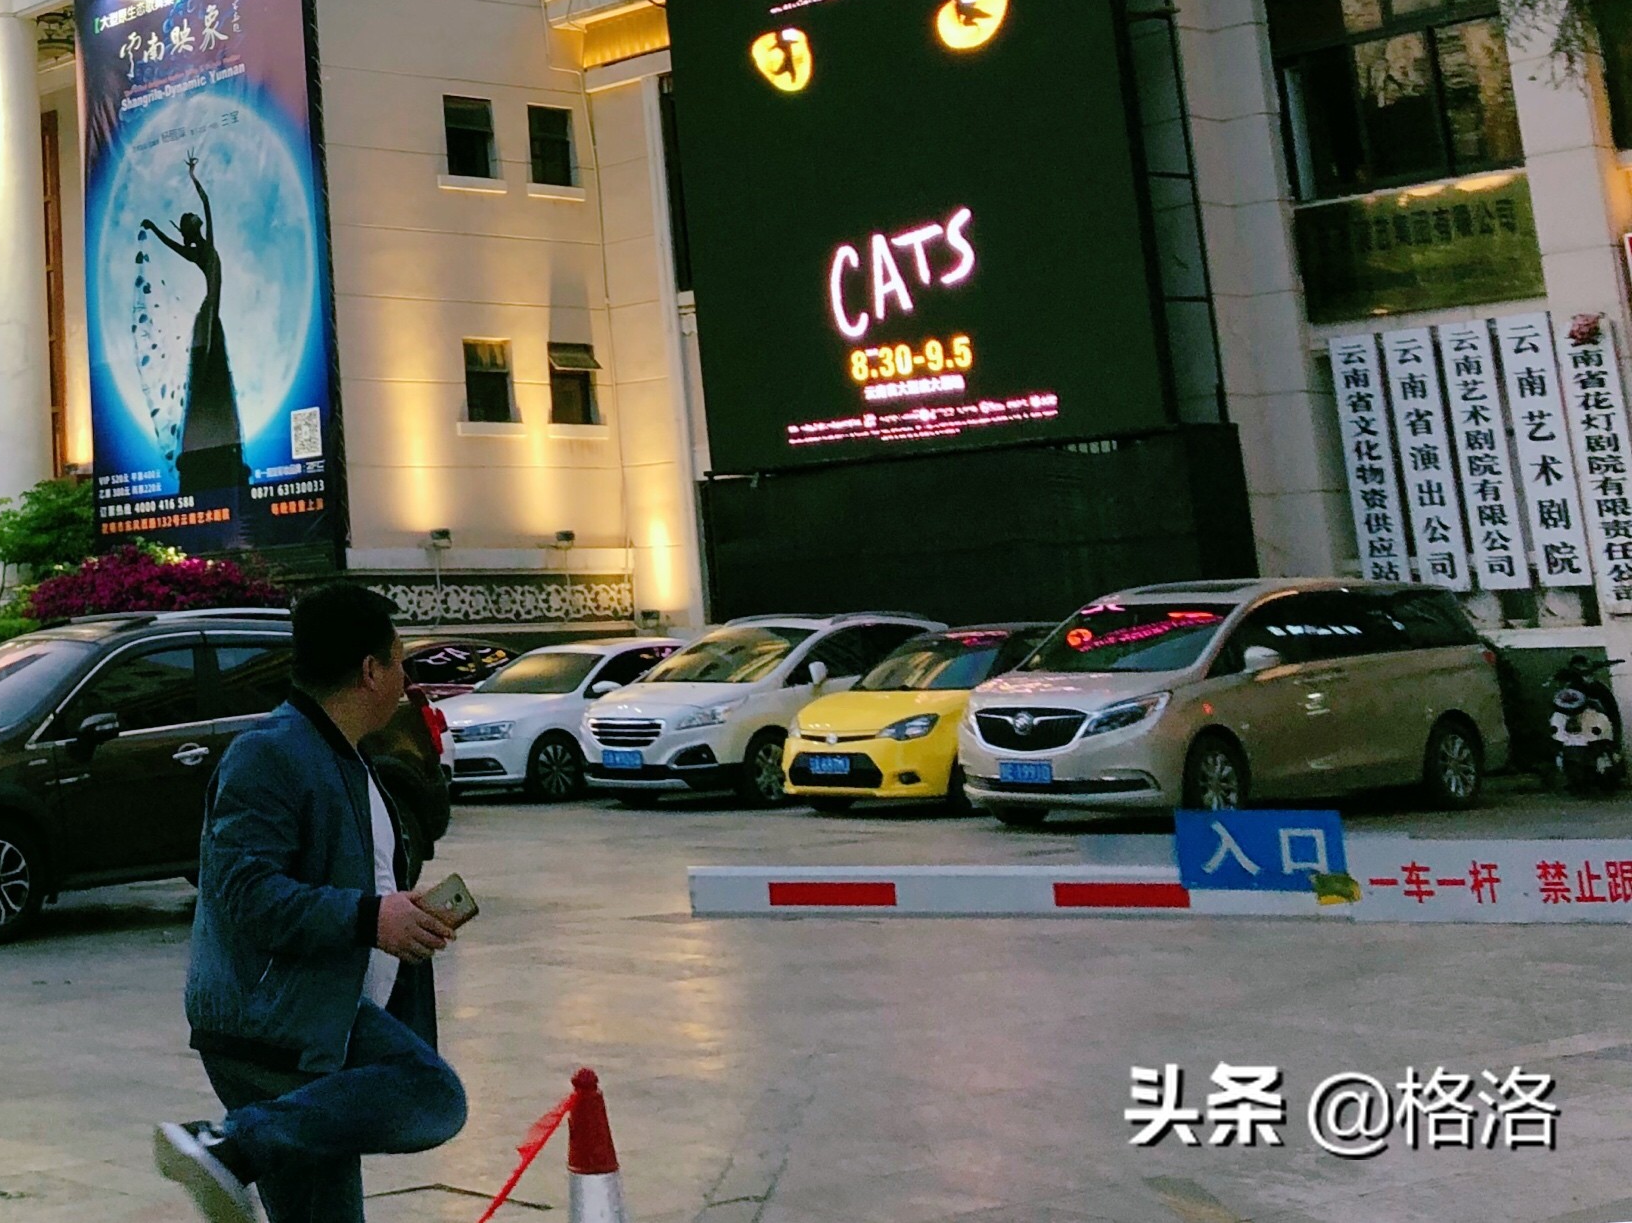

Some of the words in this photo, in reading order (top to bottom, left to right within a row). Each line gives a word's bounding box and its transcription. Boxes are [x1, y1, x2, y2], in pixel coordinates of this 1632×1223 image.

[828, 206, 977, 339] CATS
[850, 335, 973, 382] 8.30-9.5
[158, 498, 175, 511] 416
[250, 486, 274, 500] 0871
[277, 479, 325, 496] 63130033
[1337, 343, 1400, 582] 云南省文化物资供应站
[1392, 338, 1458, 581] 云南省演出公司
[1449, 331, 1516, 578] 云南艺术剧院有限公司
[1507, 324, 1583, 576] 云南艺术剧院
[1567, 325, 1632, 601] 南省花灯剧院有限责任公司
[1202, 821, 1329, 877] 入口
[1369, 861, 1503, 904] 一车一杆
